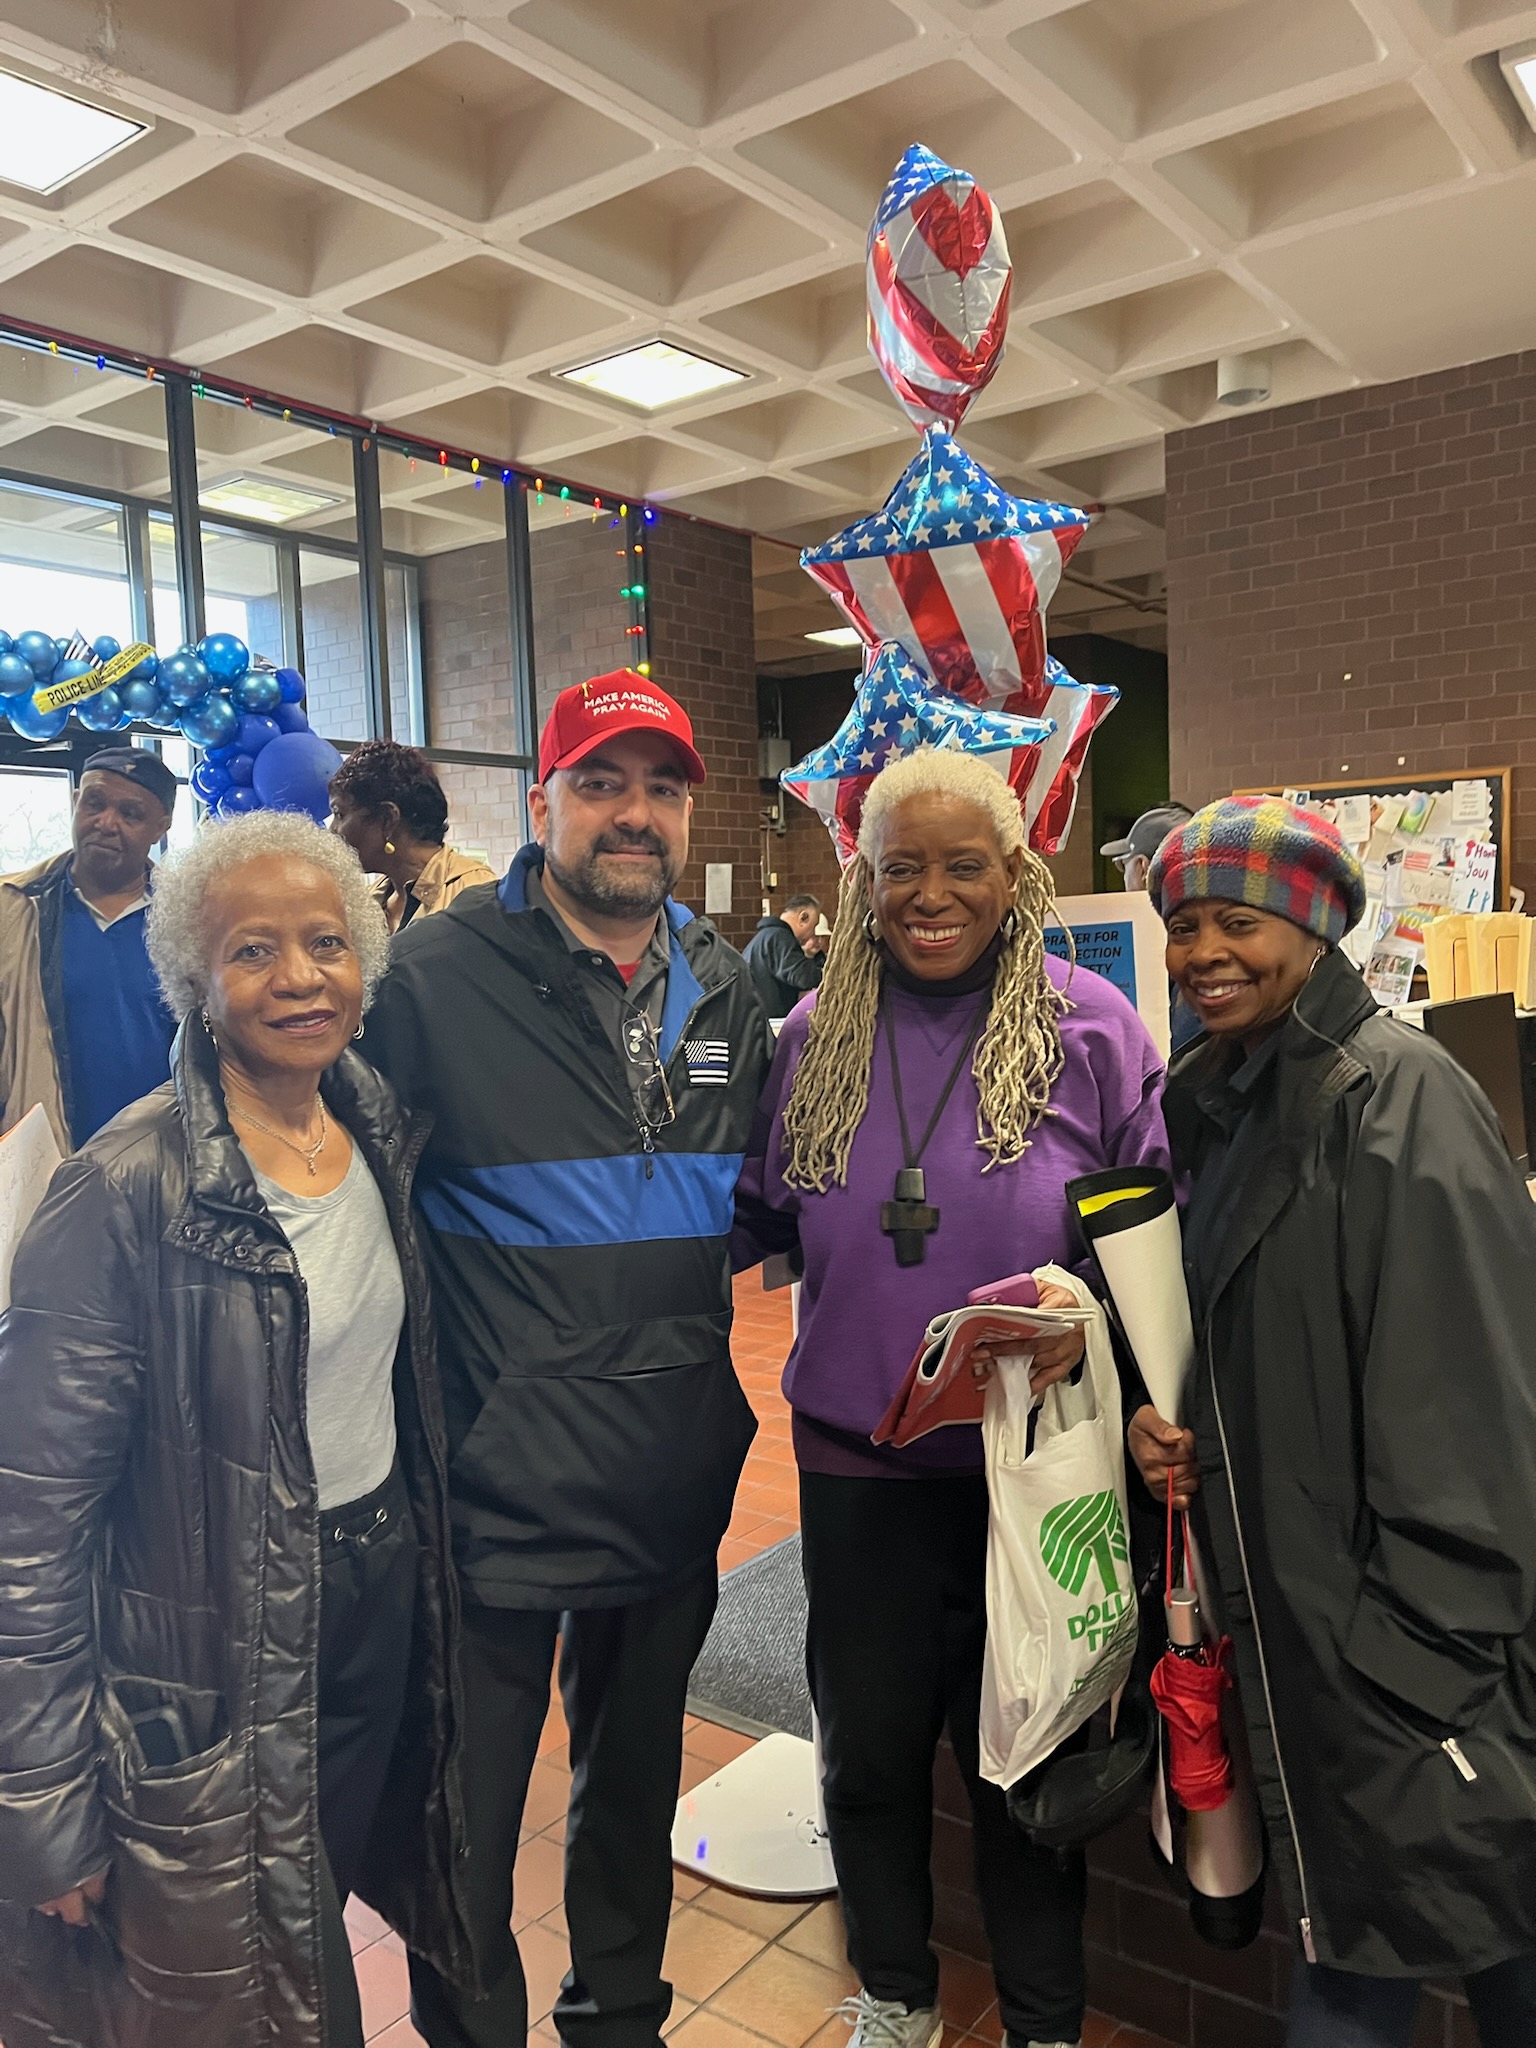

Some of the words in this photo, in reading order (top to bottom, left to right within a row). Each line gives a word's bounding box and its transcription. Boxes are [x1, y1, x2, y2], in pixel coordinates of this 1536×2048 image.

[47, 680, 86, 707] POLICE
[584, 691, 619, 709] MAKE
[621, 691, 671, 716] AMERICA
[592, 702, 627, 716] PRAY
[629, 702, 667, 720] AGAIN
[1043, 932, 1091, 946] PRAER
[1094, 930, 1119, 943] FOR
